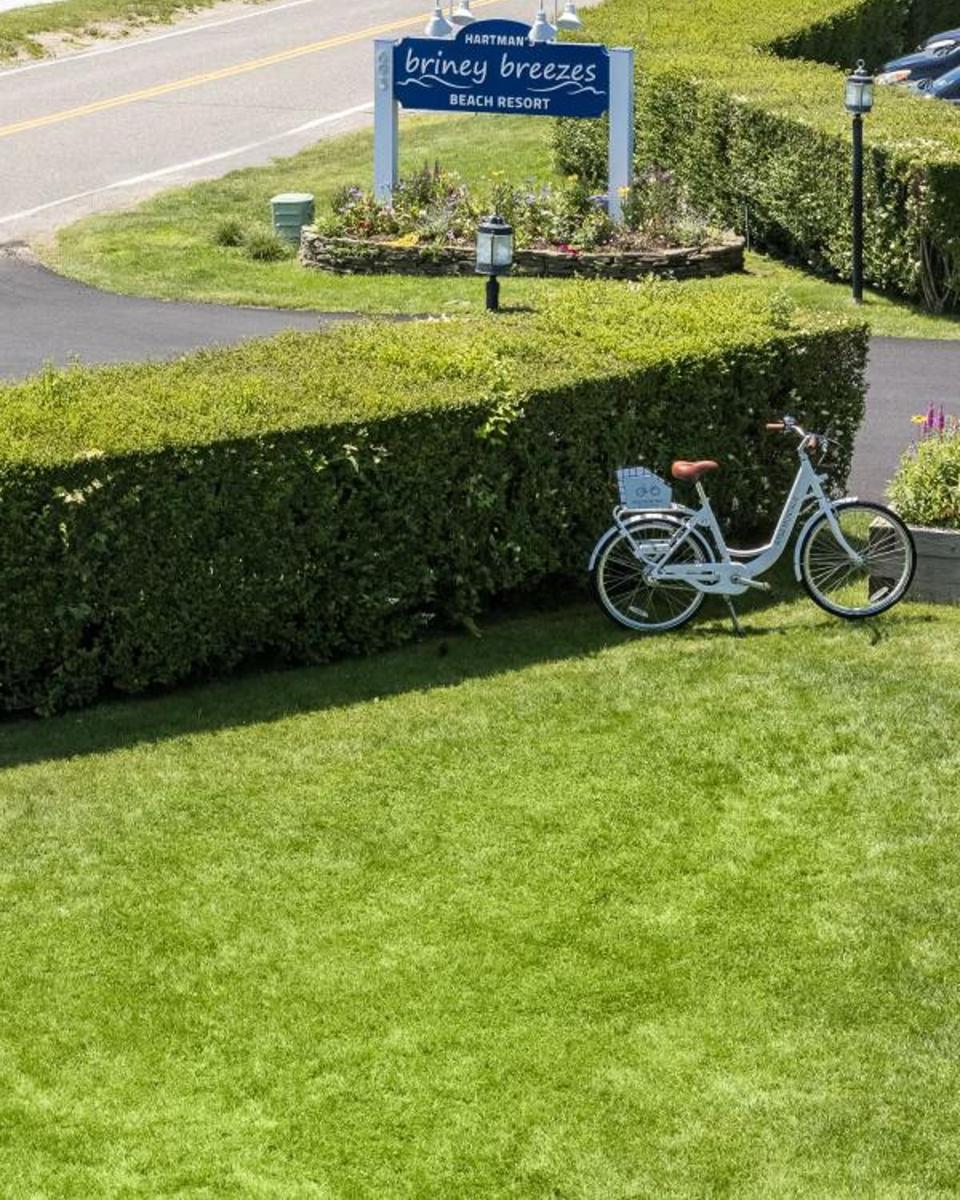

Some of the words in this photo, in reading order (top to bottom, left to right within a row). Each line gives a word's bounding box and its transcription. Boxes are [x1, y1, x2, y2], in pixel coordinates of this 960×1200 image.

[405, 48, 488, 84] briney
[500, 52, 596, 82] breezes
[449, 94, 493, 107] BEACH
[497, 95, 551, 110] RESORT
